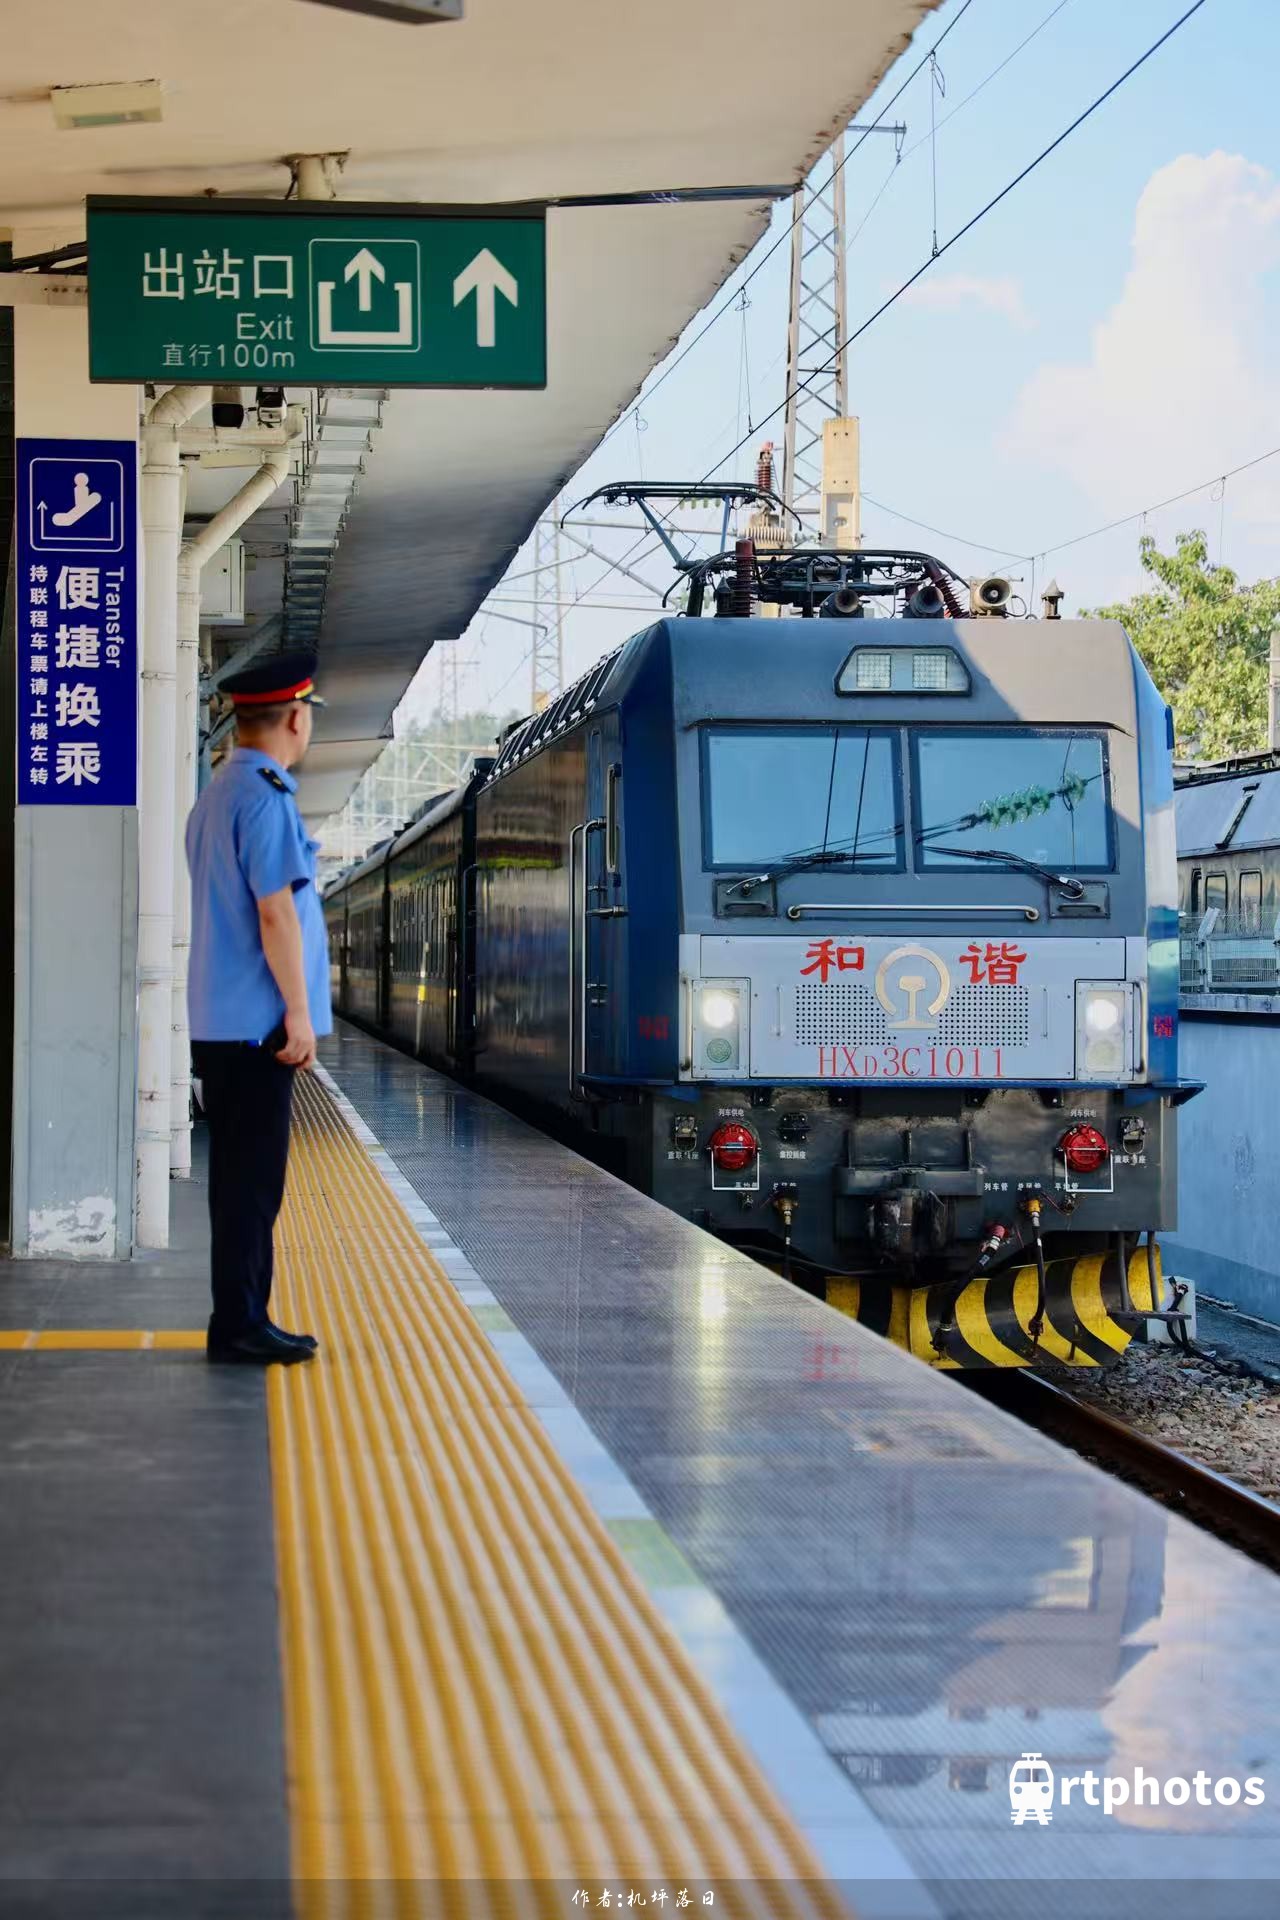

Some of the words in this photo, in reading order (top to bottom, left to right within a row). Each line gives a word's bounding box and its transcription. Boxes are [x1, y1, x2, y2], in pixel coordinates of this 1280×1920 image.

[143, 247, 294, 300] 出站口
[236, 312, 295, 340] Exit
[162, 343, 295, 368] 直行100m
[105, 566, 125, 669] Transfer
[30, 564, 49, 785] 持联程车票请上楼左转
[55, 565, 101, 786] 便捷换乘
[984, 1183, 1009, 1191] 列车管
